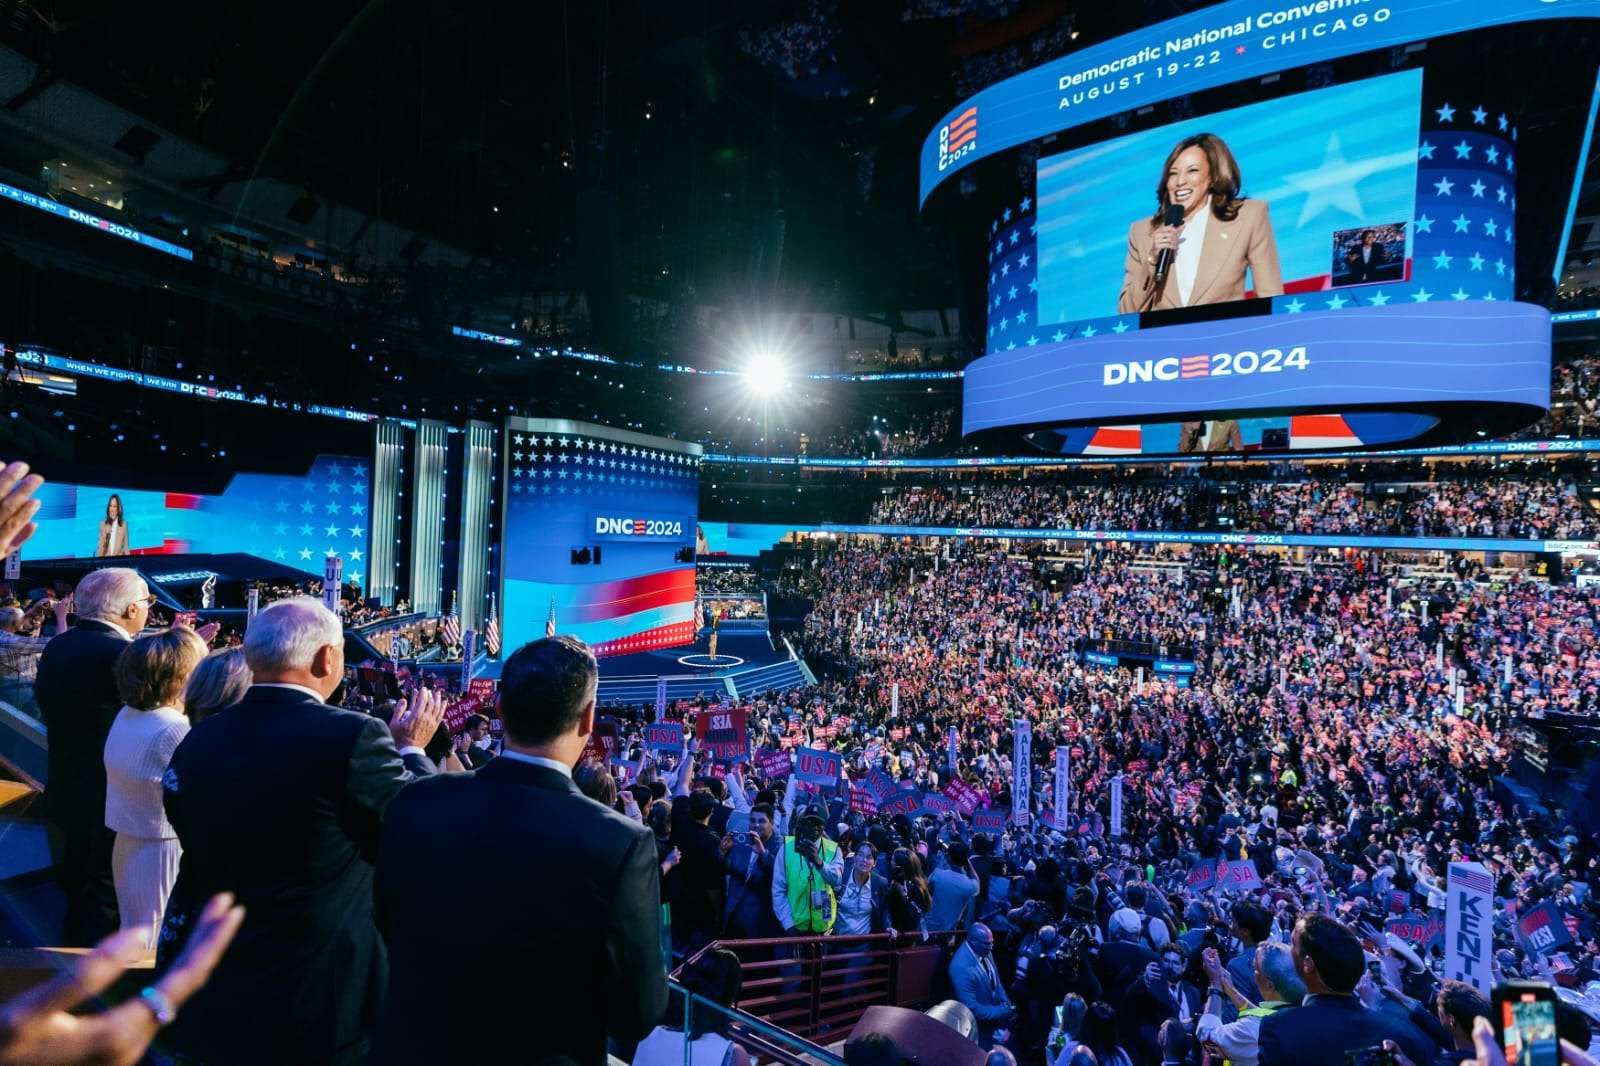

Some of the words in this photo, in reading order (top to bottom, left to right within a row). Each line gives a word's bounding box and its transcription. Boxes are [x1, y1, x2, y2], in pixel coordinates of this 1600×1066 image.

[1058, 46, 1161, 91] Democratic
[1165, 16, 1252, 55] National
[1256, 0, 1372, 29] Conven
[1058, 73, 1145, 110] AUGUST
[1157, 50, 1221, 79] 19-22
[1262, 8, 1391, 49] CHICAGO
[939, 126, 949, 171] DNC
[948, 140, 976, 165] 2024
[69, 209, 100, 227] DNC
[109, 223, 140, 241] 2024
[1103, 357, 1179, 386] DNC
[1210, 346, 1310, 376] 2024
[1508, 442, 1537, 451] DNC
[1548, 441, 1583, 449] 2024
[596, 517, 634, 535] DNC
[646, 520, 682, 536] 2024
[956, 528, 973, 536] DNC
[979, 528, 998, 536] 2024
[1076, 531, 1097, 539] DNC
[1221, 535, 1245, 543] DNC
[1255, 535, 1282, 543] 2024
[649, 728, 678, 744] USA
[800, 754, 836, 777] USA
[1018, 734, 1029, 811] ALABAMA
[884, 796, 918, 816] USA
[976, 815, 1001, 828] USA
[1232, 866, 1254, 881] SA
[1391, 923, 1424, 940] USA
[1456, 891, 1483, 988] KENT
